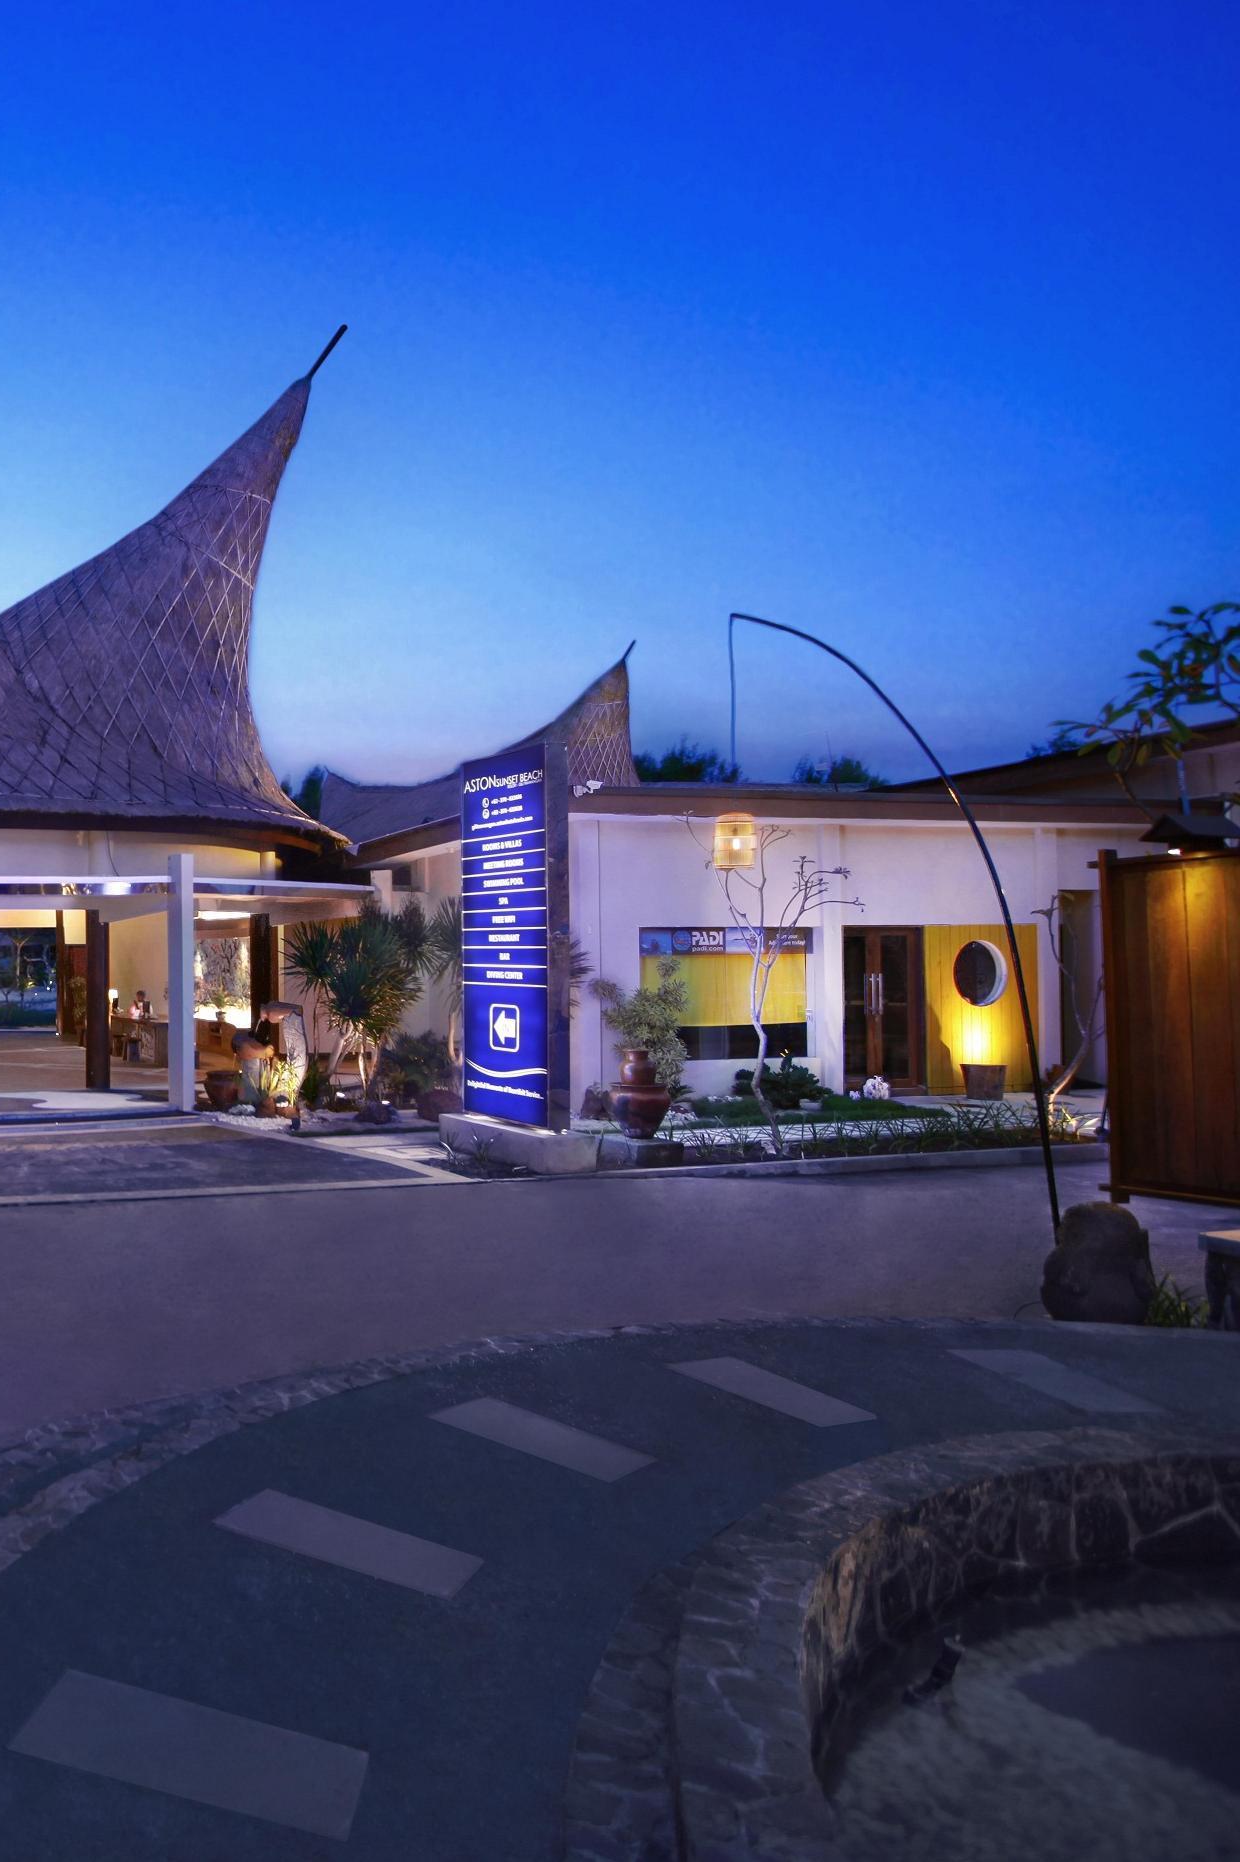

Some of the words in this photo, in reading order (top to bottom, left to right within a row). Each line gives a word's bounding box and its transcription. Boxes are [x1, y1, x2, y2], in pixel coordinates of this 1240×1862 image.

[464, 774, 496, 794] ASTON
[496, 774, 519, 787] SUNSET
[519, 769, 543, 782] BEACH
[482, 842, 500, 851] ROOMS
[504, 839, 522, 848] VILLAS
[483, 860, 505, 869] MEETING
[505, 858, 524, 867] ROOMS
[483, 878, 510, 888] SWIMMING
[510, 877, 524, 885] POOL
[498, 897, 509, 905] SPA
[492, 915, 504, 924] FREE
[488, 933, 520, 942] RESTAURANT
[691, 931, 724, 946] PADI
[691, 945, 724, 953] padi.com
[499, 952, 511, 961] BAR
[486, 970, 505, 979] DIVING
[504, 971, 523, 980] CENTER
